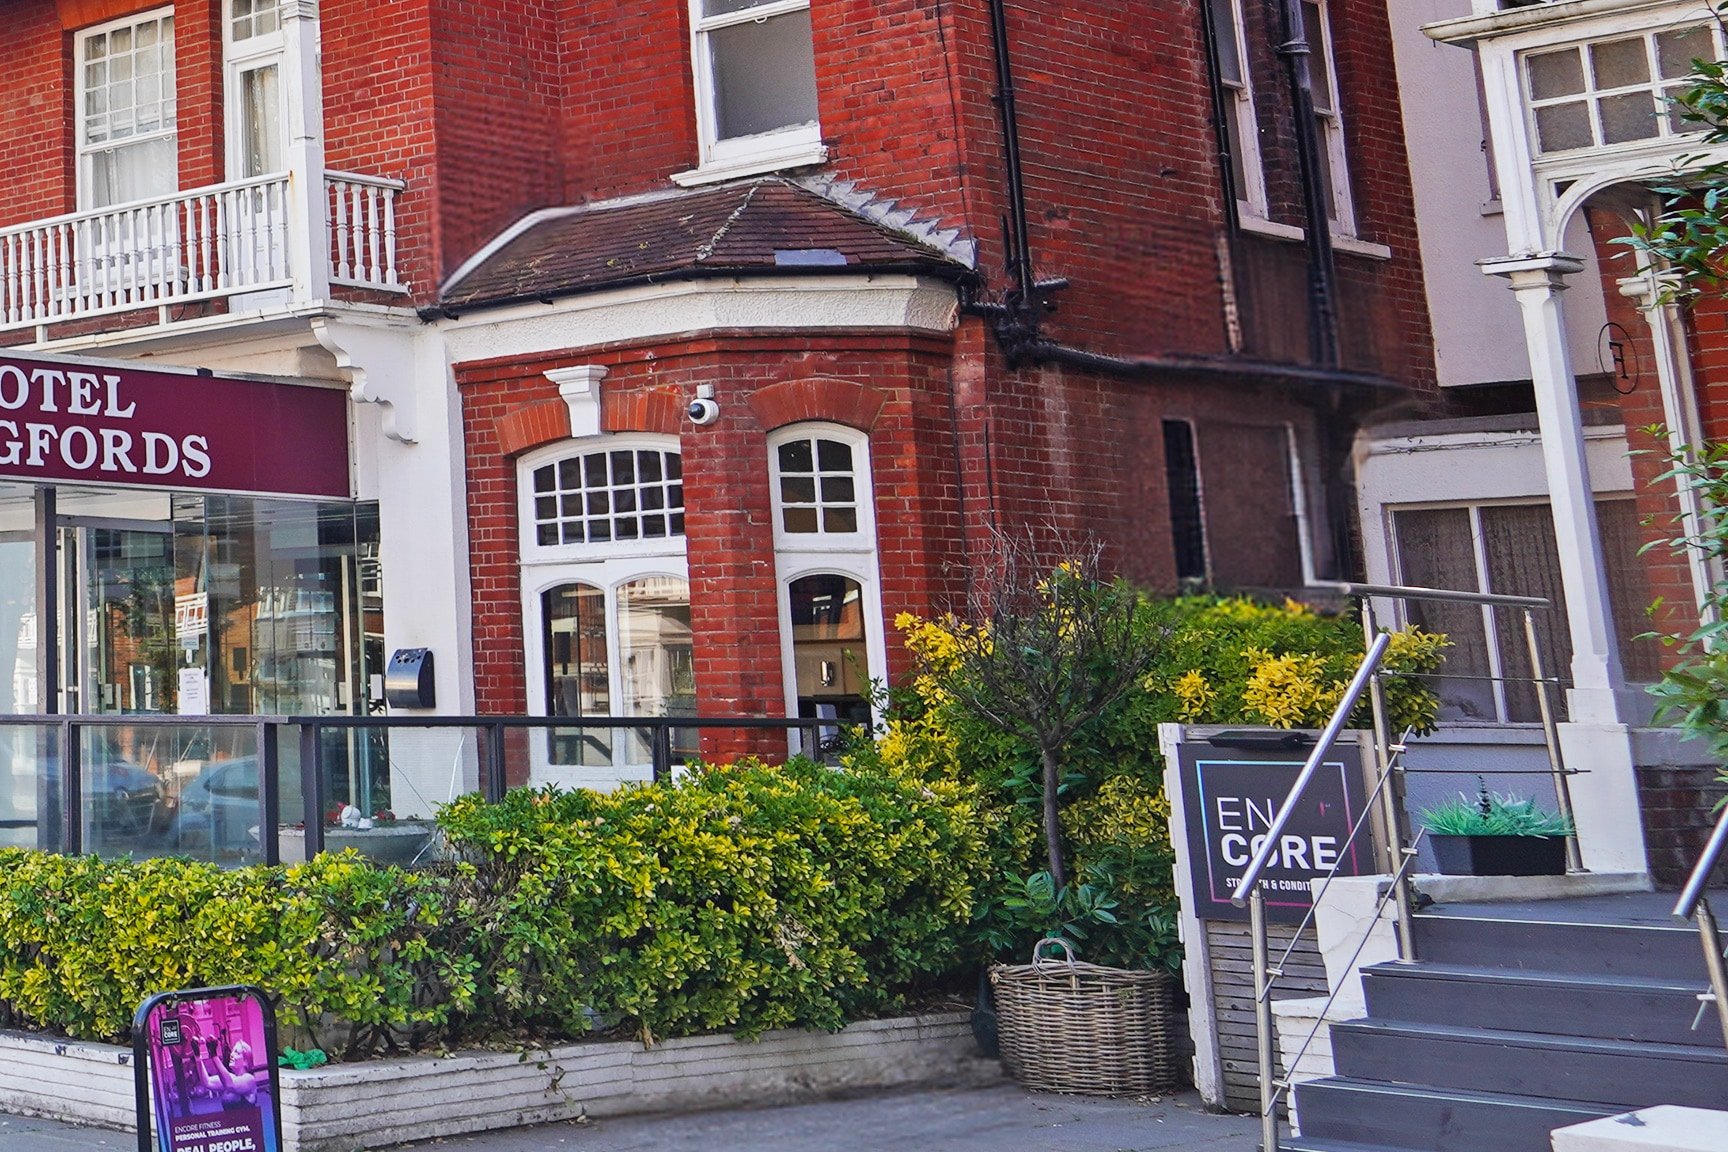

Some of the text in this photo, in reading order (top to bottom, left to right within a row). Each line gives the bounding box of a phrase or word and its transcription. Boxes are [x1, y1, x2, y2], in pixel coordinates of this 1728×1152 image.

[1216, 796, 1274, 831] EN
[174, 1121, 221, 1134] ENCORE FITNESS
[175, 1131, 207, 1141] PERSONAL
[207, 1128, 235, 1137] TRAINING
[209, 1138, 256, 1152] PEOPLE,
